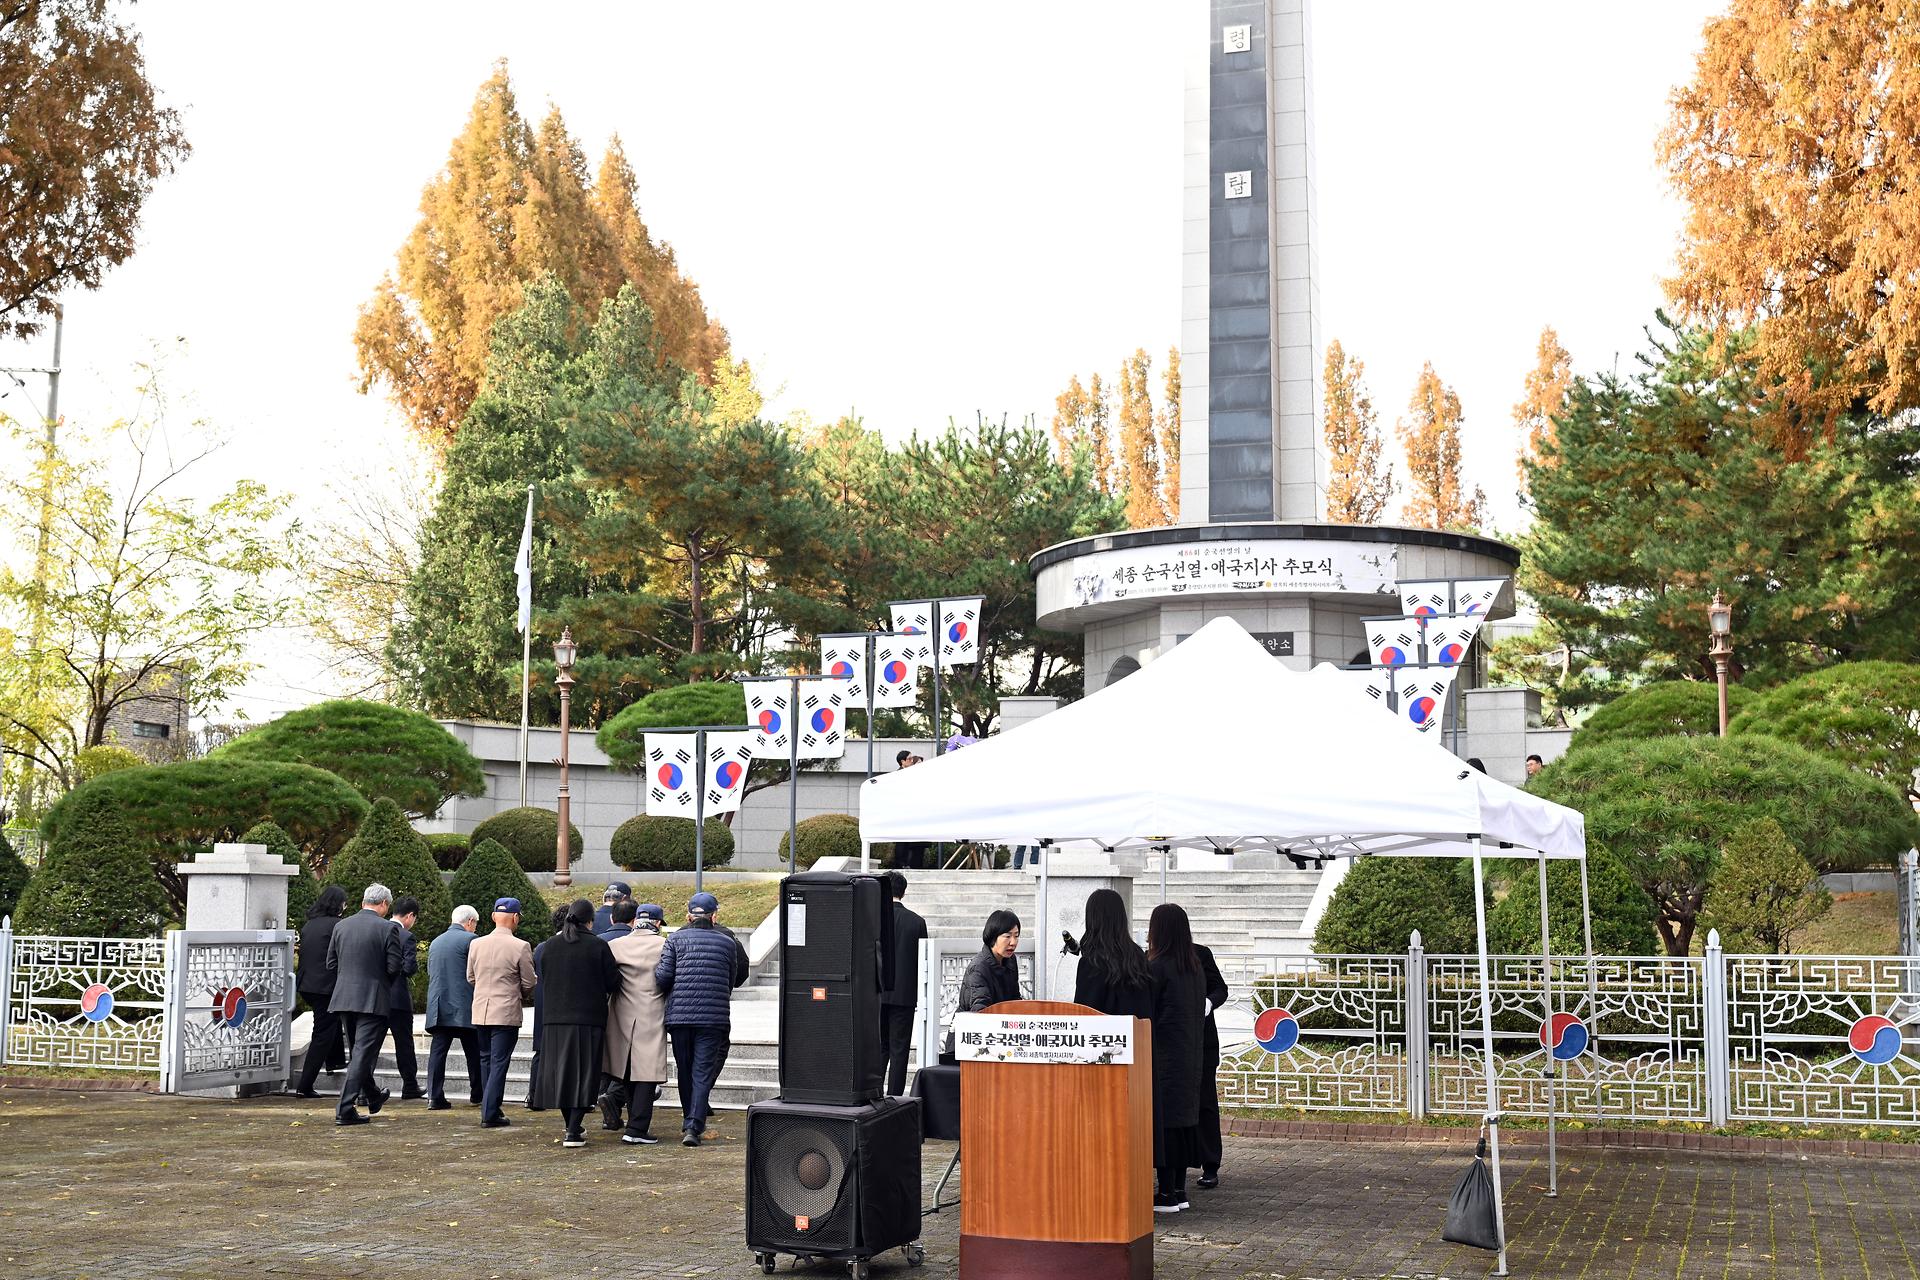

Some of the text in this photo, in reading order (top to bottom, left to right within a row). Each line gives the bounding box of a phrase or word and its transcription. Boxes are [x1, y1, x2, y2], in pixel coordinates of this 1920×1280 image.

[1177, 546, 1251, 557] 제86회 순국선열의 날
[1112, 557, 1333, 584] 세종 순국선열·애국지사 추모식
[1001, 1020, 1078, 1031] 제86회 순국선열의 날
[960, 1031, 1127, 1048] 세종 순국선열·애국지사 추모식
